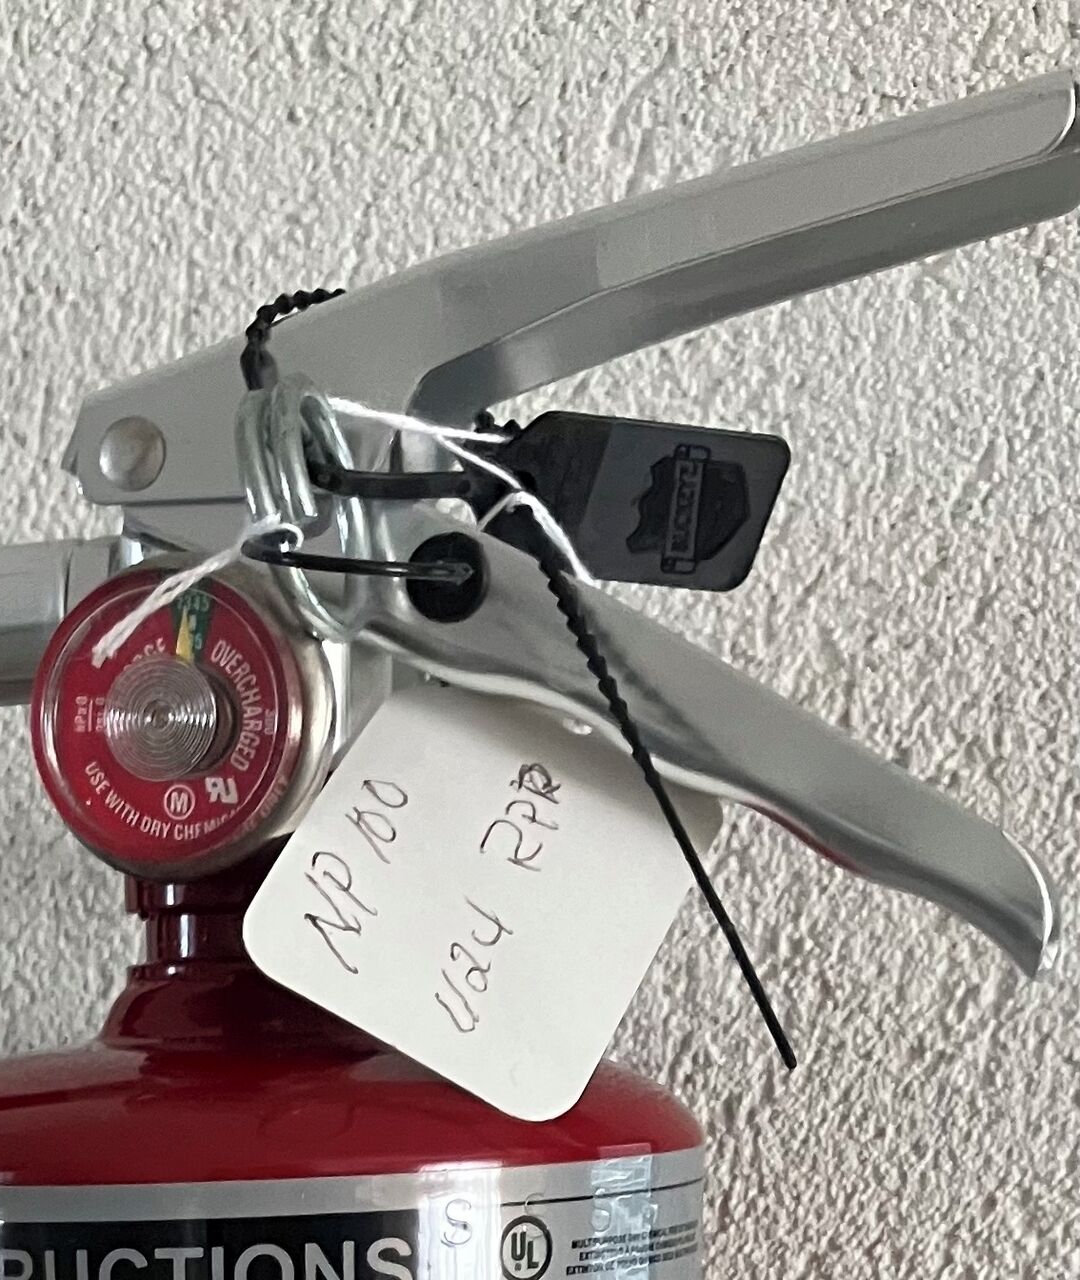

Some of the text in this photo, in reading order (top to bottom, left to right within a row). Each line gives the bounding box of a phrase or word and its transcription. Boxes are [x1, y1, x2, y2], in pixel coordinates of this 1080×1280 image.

[210, 640, 265, 771] OVERCHARGED
[84, 761, 108, 796] USE
[106, 791, 140, 828] WITH
[140, 815, 172, 840] DRY
